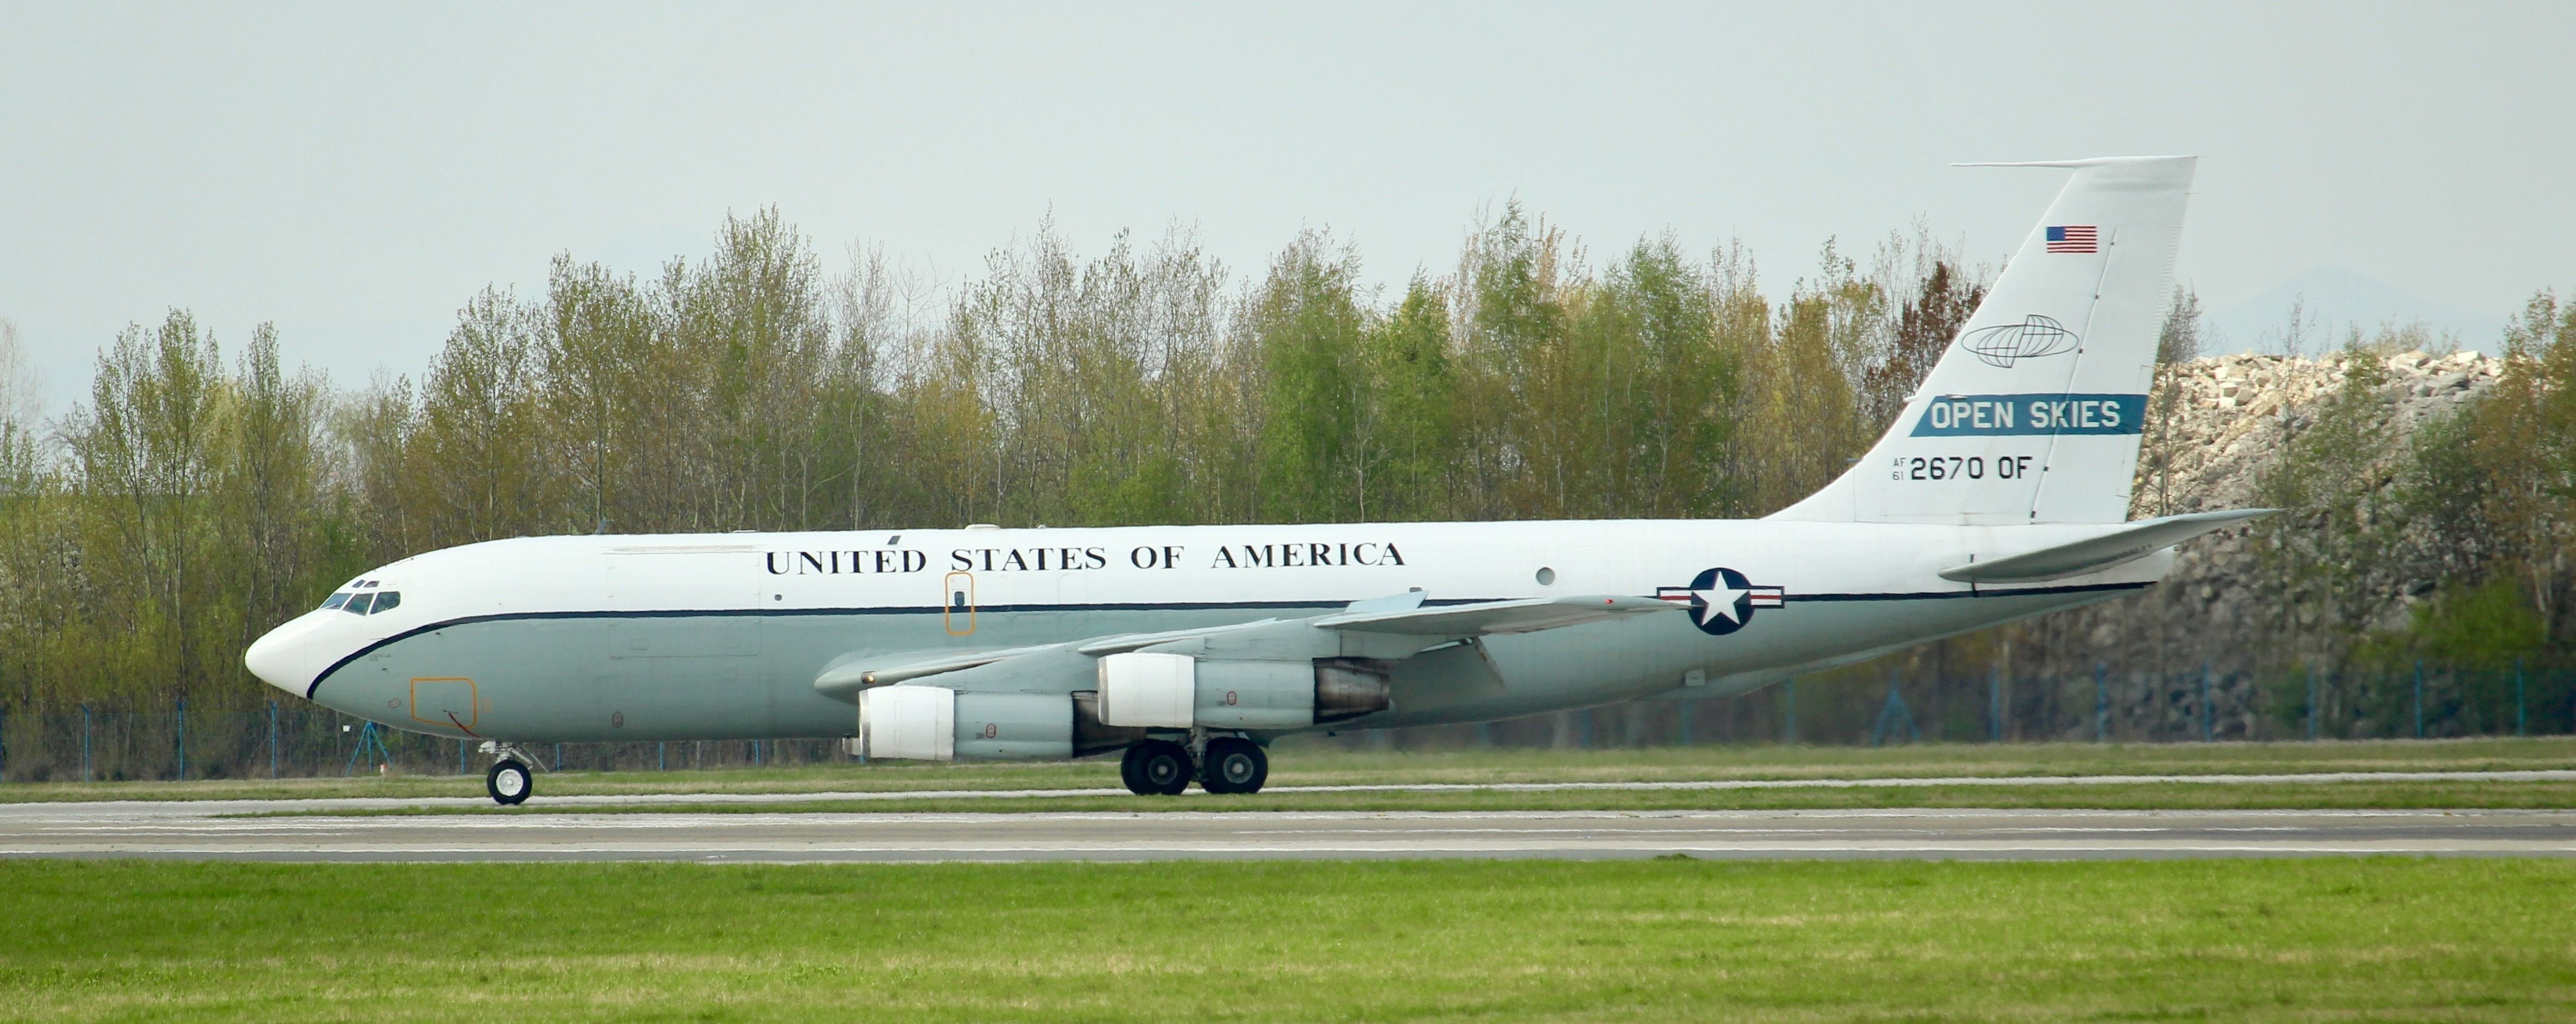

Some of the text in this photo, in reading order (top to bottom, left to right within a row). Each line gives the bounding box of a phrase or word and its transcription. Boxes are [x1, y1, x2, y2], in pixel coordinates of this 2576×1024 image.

[1932, 401, 2120, 428] OPEN SKIES
[1893, 457, 1907, 467] AF
[1910, 456, 1984, 480] 2670
[1892, 471, 1904, 481] 61
[767, 542, 1406, 575] UNITED STATES OF AMERICA
